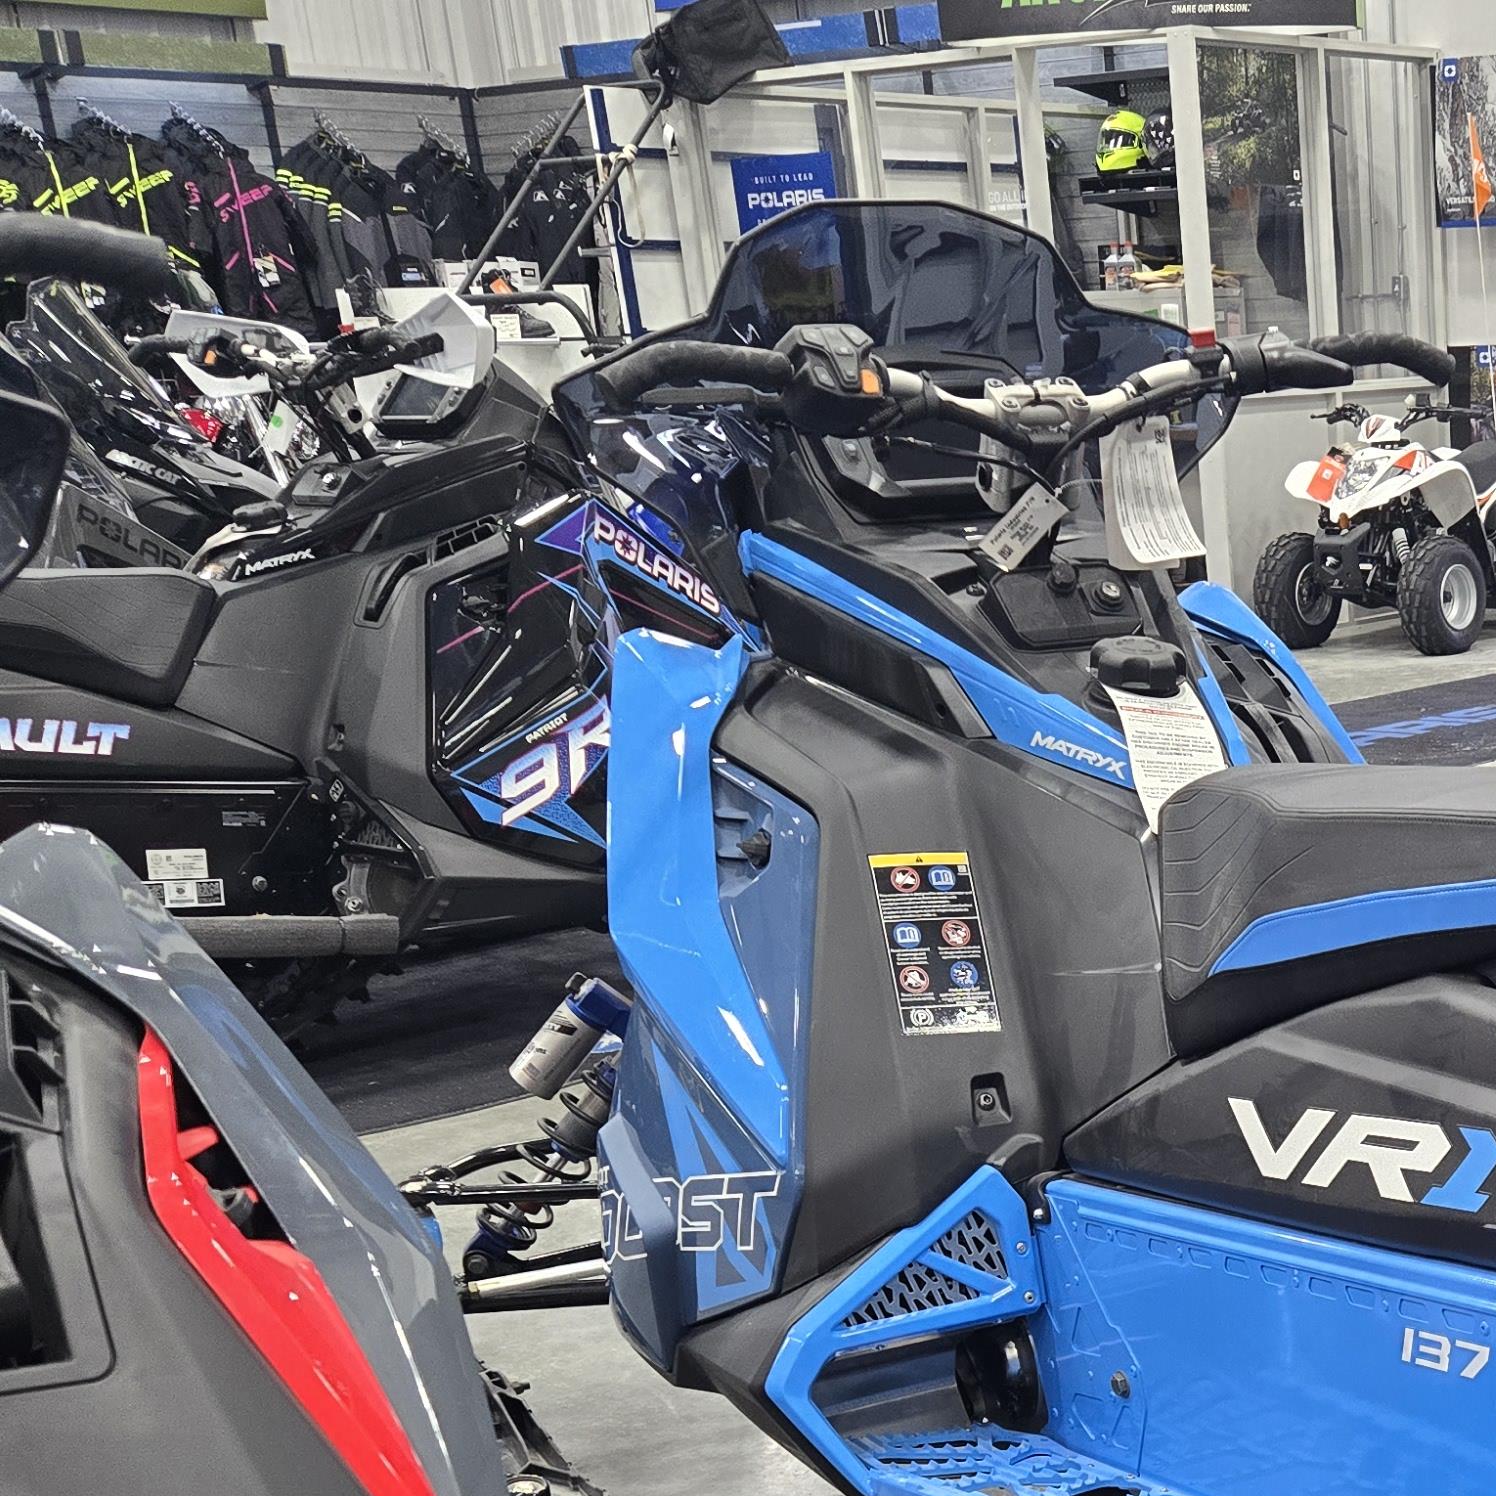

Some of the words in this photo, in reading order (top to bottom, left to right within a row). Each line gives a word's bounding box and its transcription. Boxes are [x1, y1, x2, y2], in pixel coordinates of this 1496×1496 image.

[1171, 4, 1196, 14] SHARE
[1198, 4, 1213, 13] OUR
[754, 175, 777, 185] BUILT
[780, 174, 790, 183] TO
[793, 172, 814, 182] LEAD
[747, 188, 825, 209] POLARIS
[245, 548, 315, 576] MATRYX
[593, 513, 721, 614] POLARIS
[525, 712, 568, 744] PATRIOT
[1029, 730, 1127, 781] MATRYX
[1401, 1327, 1490, 1379] 137
